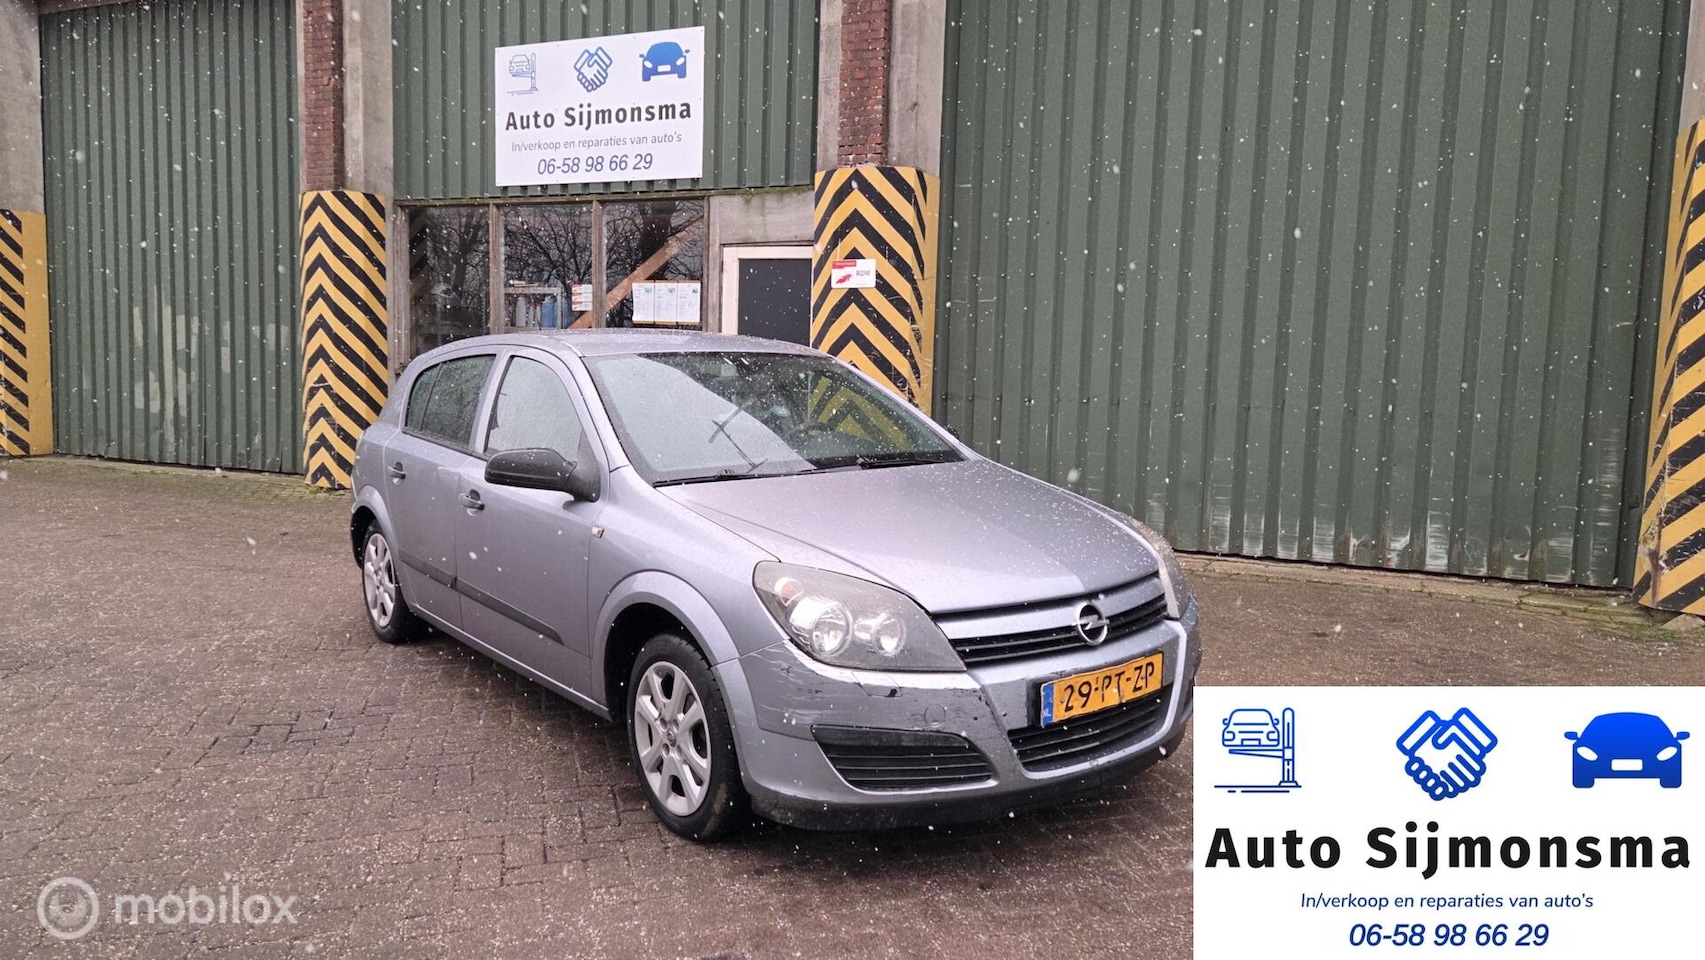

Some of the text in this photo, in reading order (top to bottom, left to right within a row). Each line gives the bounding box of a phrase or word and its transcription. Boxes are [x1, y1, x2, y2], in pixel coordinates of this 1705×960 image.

[505, 102, 692, 131] Auto Sijmonsma
[511, 131, 682, 152] In/verkoop en reparaties van auto's
[537, 153, 653, 175] 06-58 98 66 29
[1062, 660, 1155, 713] 29-PT-ZP
